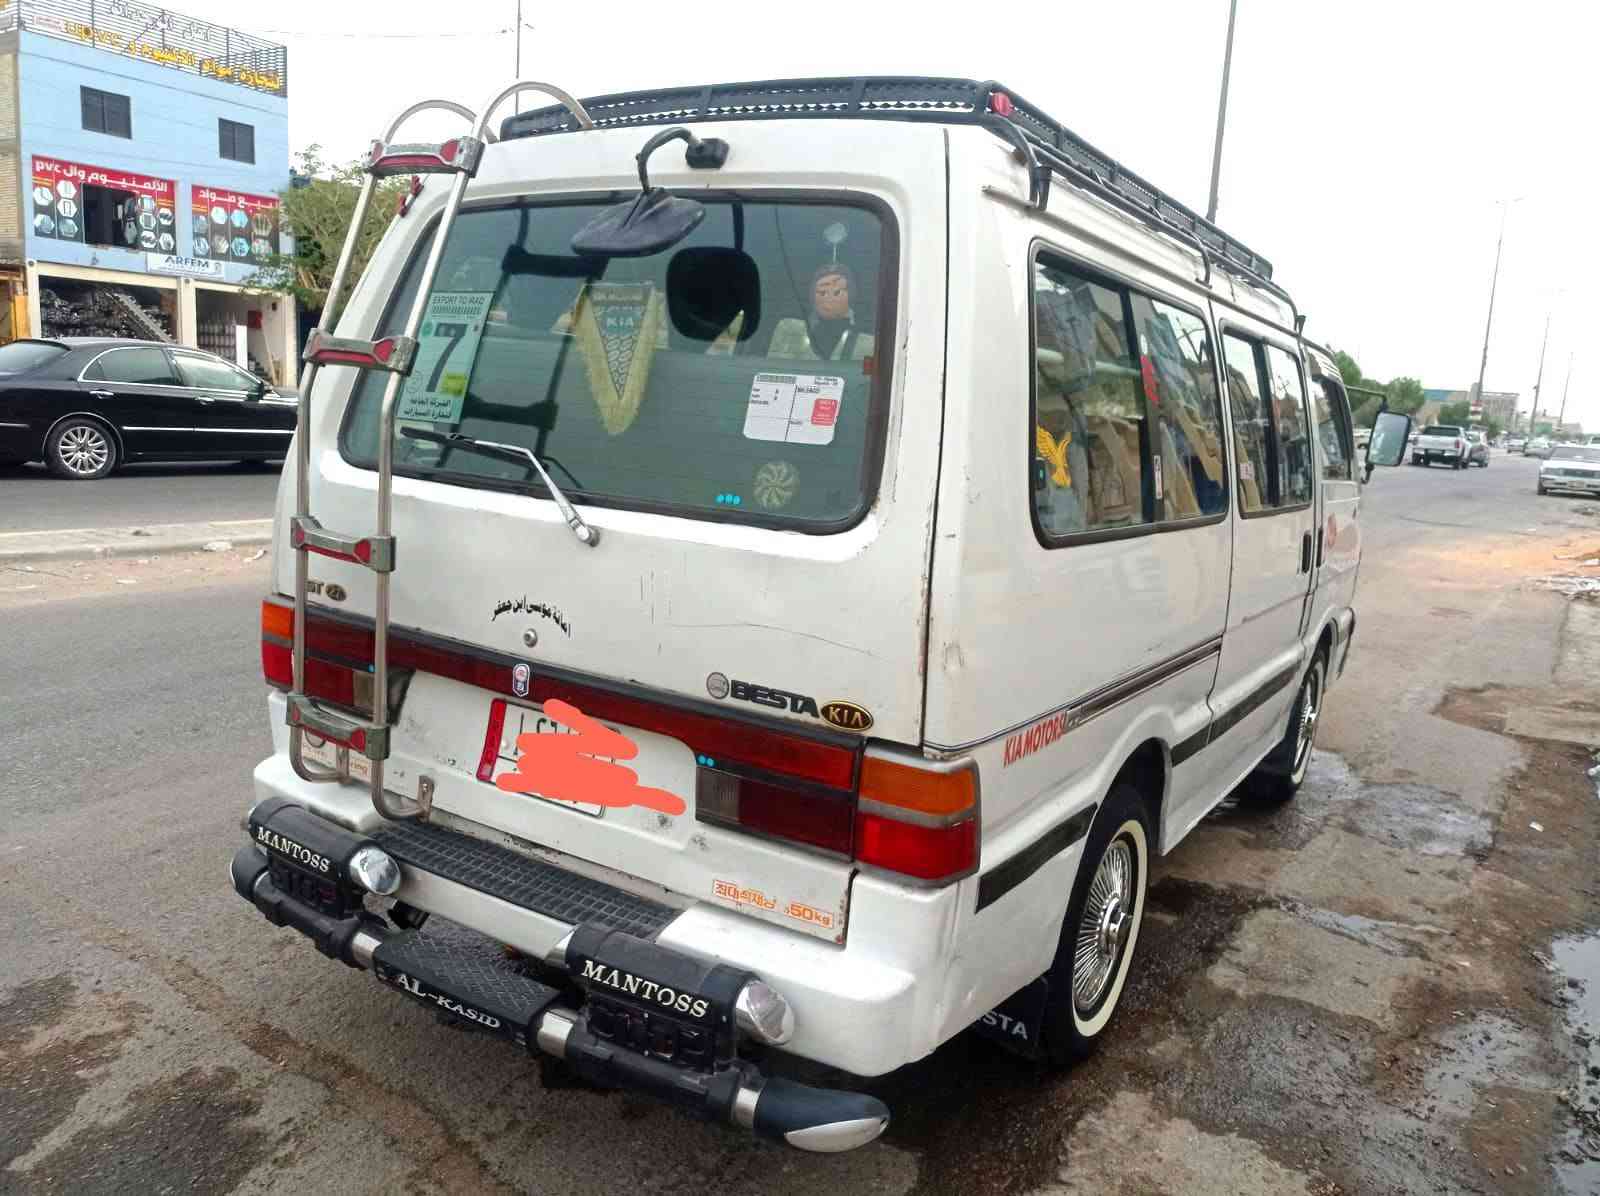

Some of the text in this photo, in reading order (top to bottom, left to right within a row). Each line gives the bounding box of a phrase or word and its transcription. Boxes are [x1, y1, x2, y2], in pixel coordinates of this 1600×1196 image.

[432, 295, 457, 305] EXPORT
[459, 295, 468, 305] TO
[606, 316, 635, 329] KIA
[425, 322, 468, 393] 7
[730, 679, 820, 719] BESTA
[828, 706, 865, 728] KIA
[1003, 735, 1024, 768] KIA
[257, 826, 331, 873] MANTOSS
[397, 973, 501, 1029] AL-KASID
[581, 959, 710, 1018] MANTOSS
